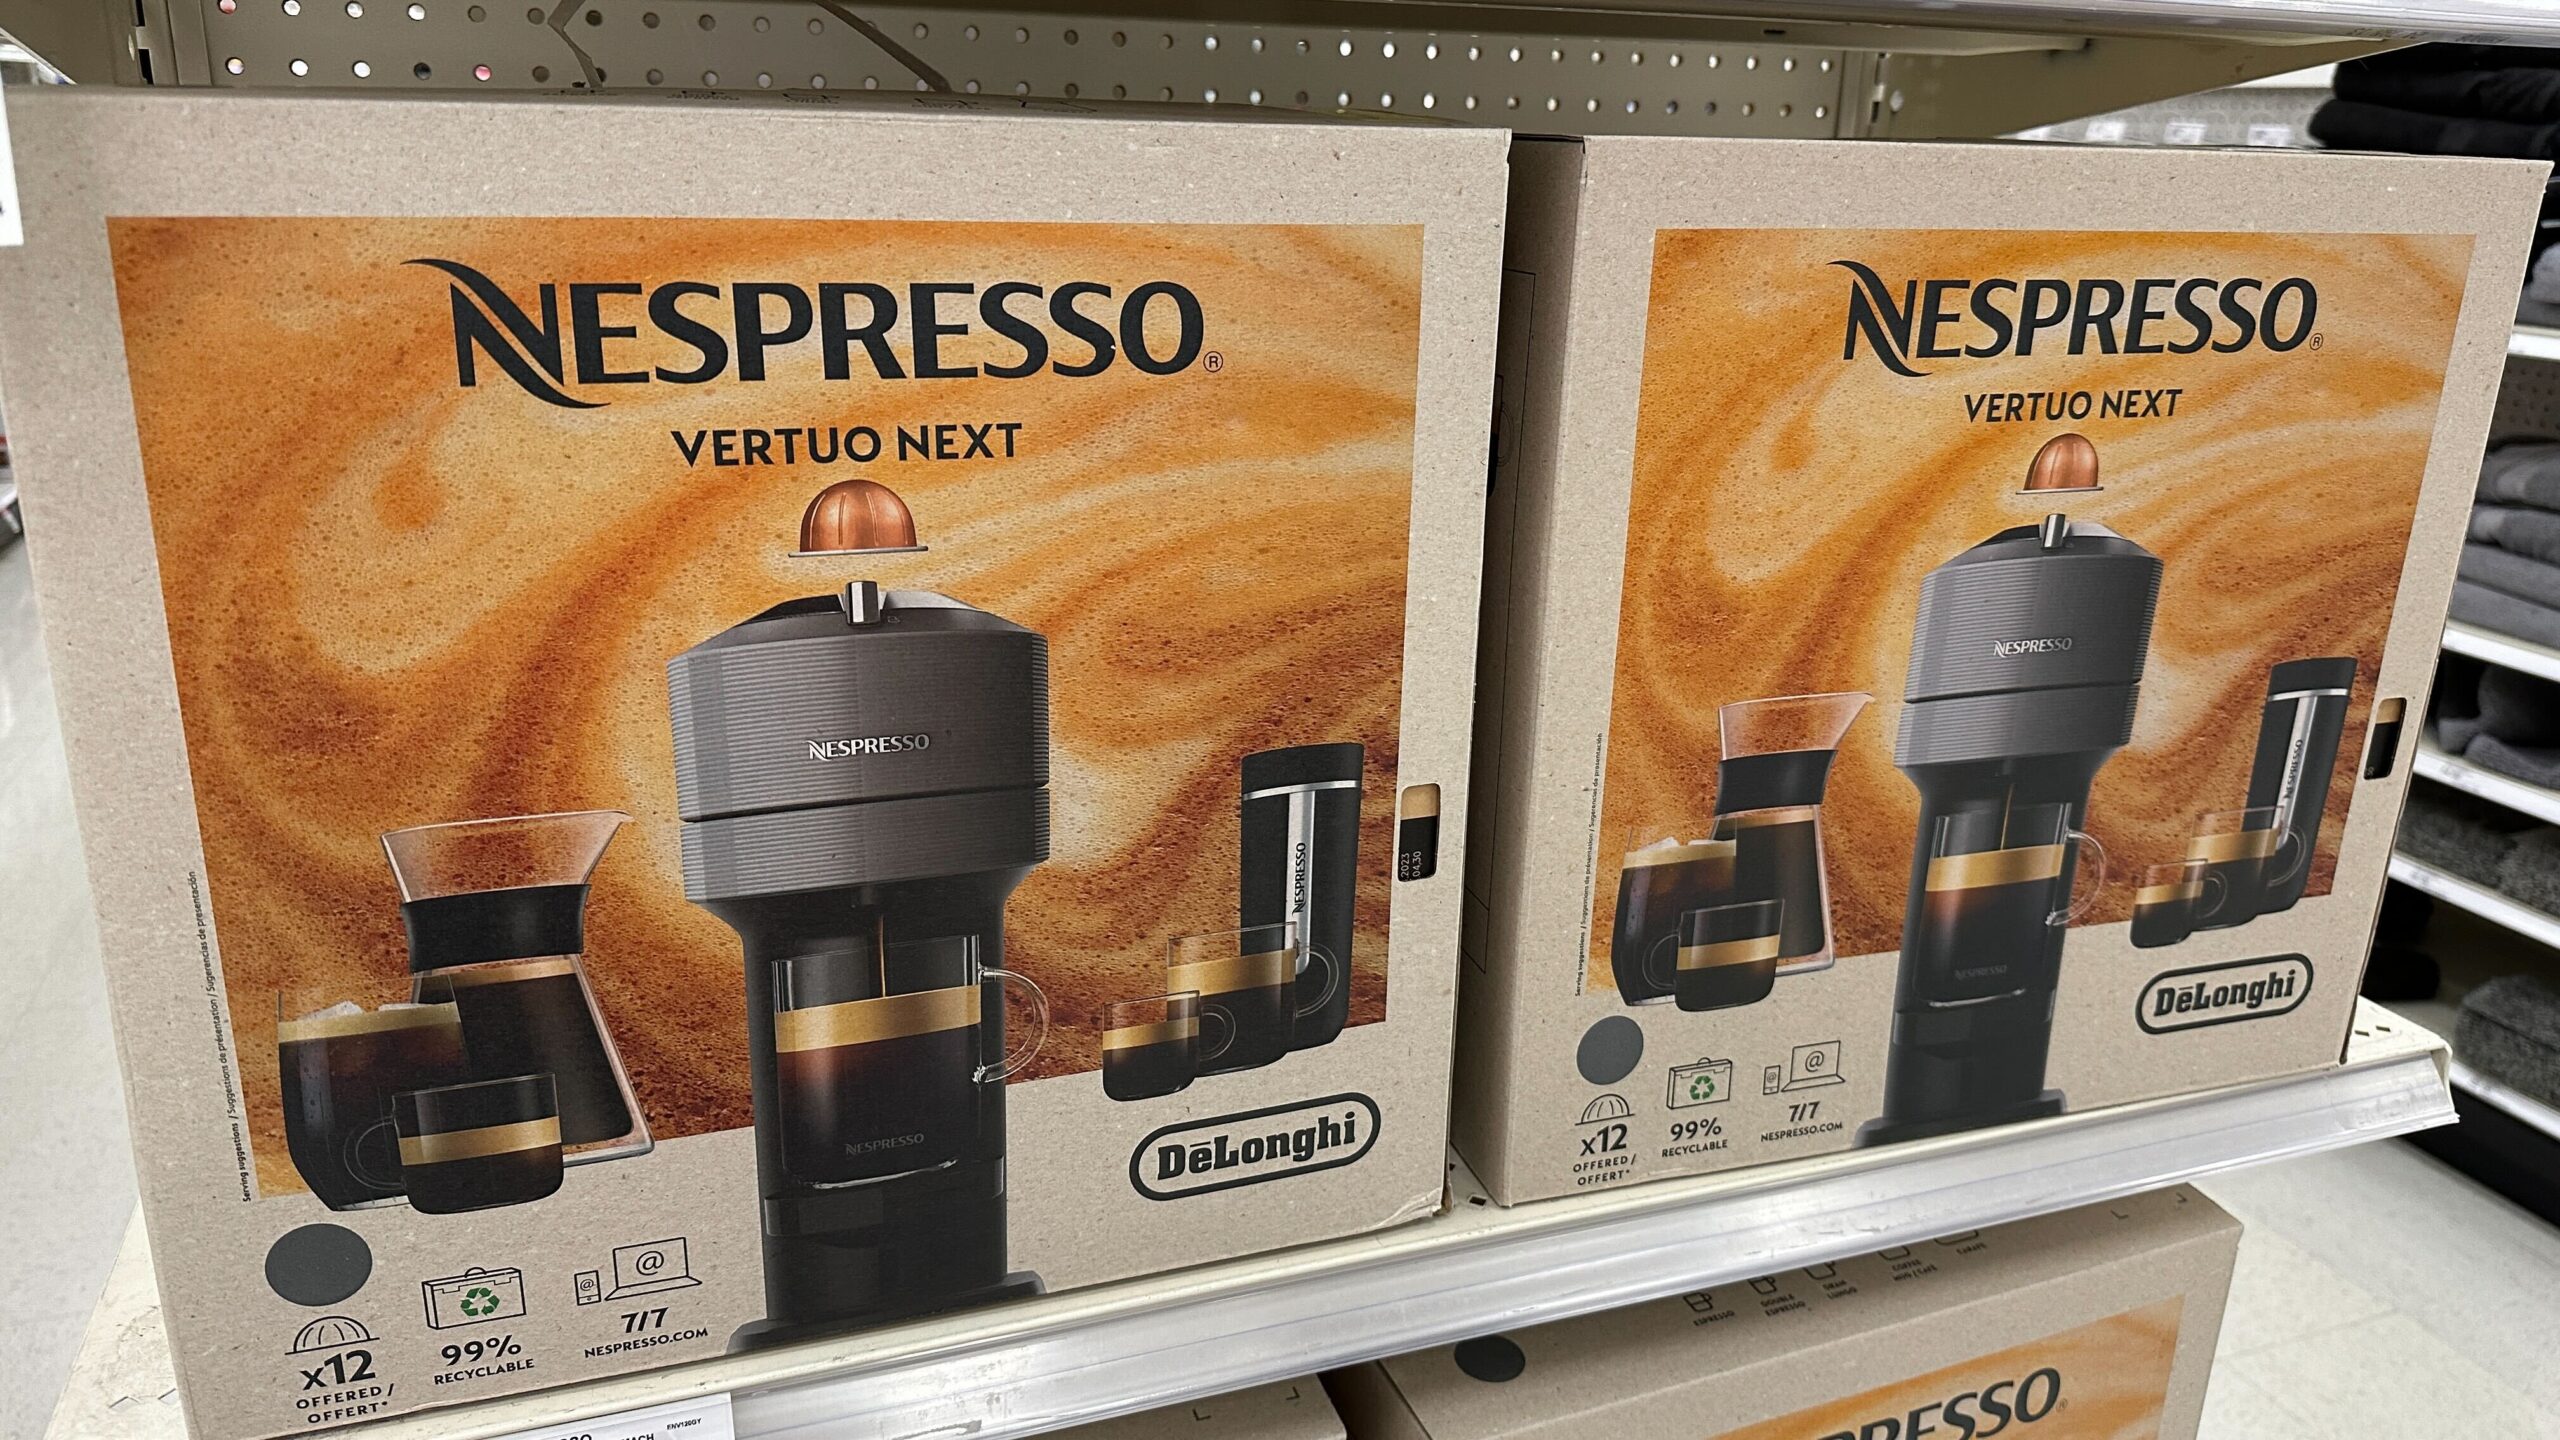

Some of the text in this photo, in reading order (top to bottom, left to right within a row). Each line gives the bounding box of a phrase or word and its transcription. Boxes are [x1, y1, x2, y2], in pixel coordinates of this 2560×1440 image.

[400, 259, 1203, 408] NESPRESSO
[1826, 260, 2317, 377] NESPRESSO
[1964, 389, 2182, 423] VERTUO NEXT
[672, 423, 1023, 468] VERTUO NEXT
[1993, 637, 2072, 659] NESPRESSO
[803, 734, 930, 761] NESPRESSO
[1292, 842, 1306, 916] NESPRESSO
[1401, 853, 1410, 878] 2023
[189, 871, 206, 926] presentación
[197, 929, 206, 940] de
[200, 941, 216, 992] Sugerencias
[210, 999, 227, 1050] présentation
[218, 1052, 227, 1063] de
[222, 1065, 236, 1114] Suggestions
[1789, 1101, 1820, 1122] 7/7
[845, 1133, 924, 1155] NESPRESSO
[1580, 1124, 1627, 1156] x12
[1670, 1117, 1722, 1141] 99%
[1761, 1121, 1843, 1143] NESPRESSO.COM
[232, 1123, 246, 1170] suggestions
[1662, 1139, 1728, 1158] RECYCLABLE
[1573, 1155, 1628, 1173] OFFERED
[239, 1172, 251, 1202] Serving
[621, 1307, 670, 1334] 7/7
[441, 1335, 522, 1366] 99%
[584, 1327, 708, 1359] NESPRESSO.COM
[300, 1350, 376, 1391] x12
[434, 1358, 534, 1385] RECYCLABLE
[296, 1386, 382, 1409] OFFERED
